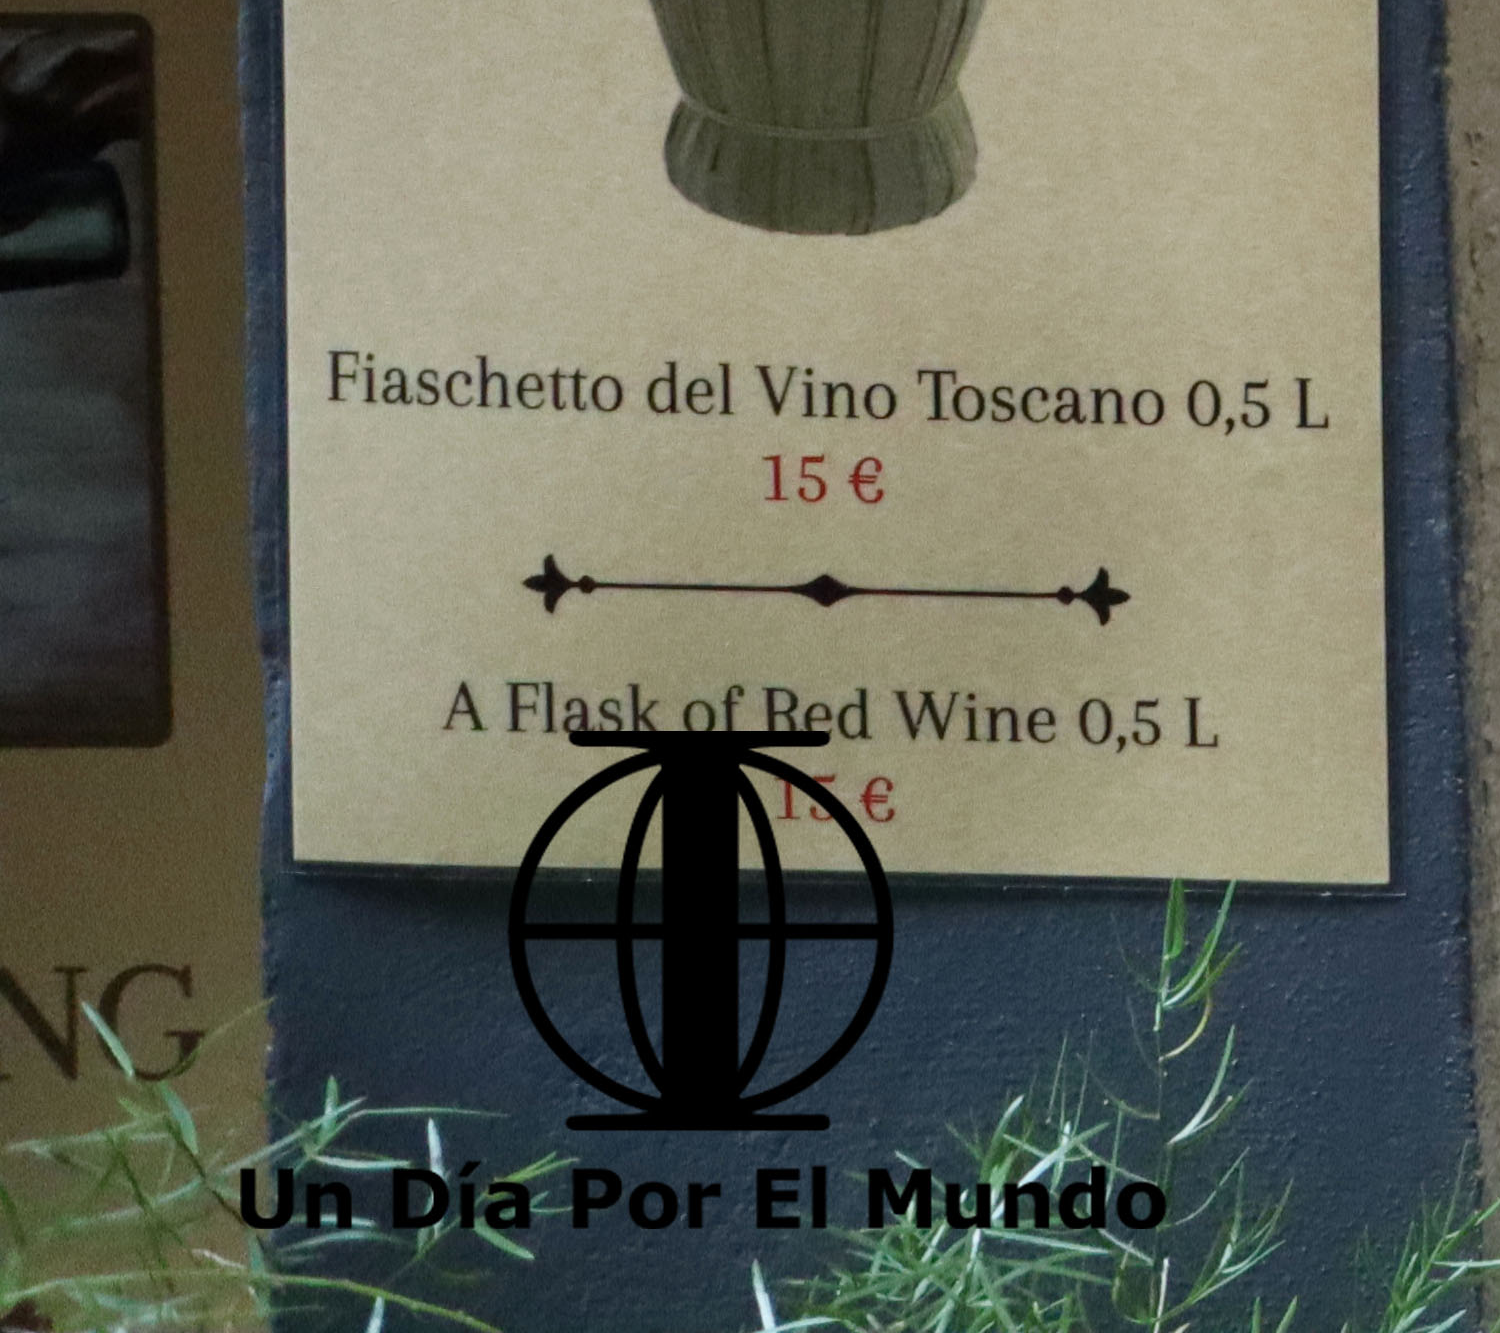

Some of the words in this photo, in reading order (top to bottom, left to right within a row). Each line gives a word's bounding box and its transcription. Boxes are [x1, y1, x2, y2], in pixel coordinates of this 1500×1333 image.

[327, 350, 625, 413] Fiaschetto
[646, 361, 735, 417] del
[755, 364, 898, 421] Vino
[917, 369, 1166, 426] Toscano
[1187, 378, 1271, 436] 0,5
[1295, 377, 1330, 430] L
[762, 453, 829, 504] 15
[847, 455, 886, 505] €
[442, 680, 488, 732] A
[505, 680, 660, 735] Flask
[682, 684, 746, 734] of
[761, 686, 873, 740] Red
[893, 689, 1056, 744] Wine
[1078, 697, 1163, 754] 0,5
[1184, 696, 1219, 748] L
